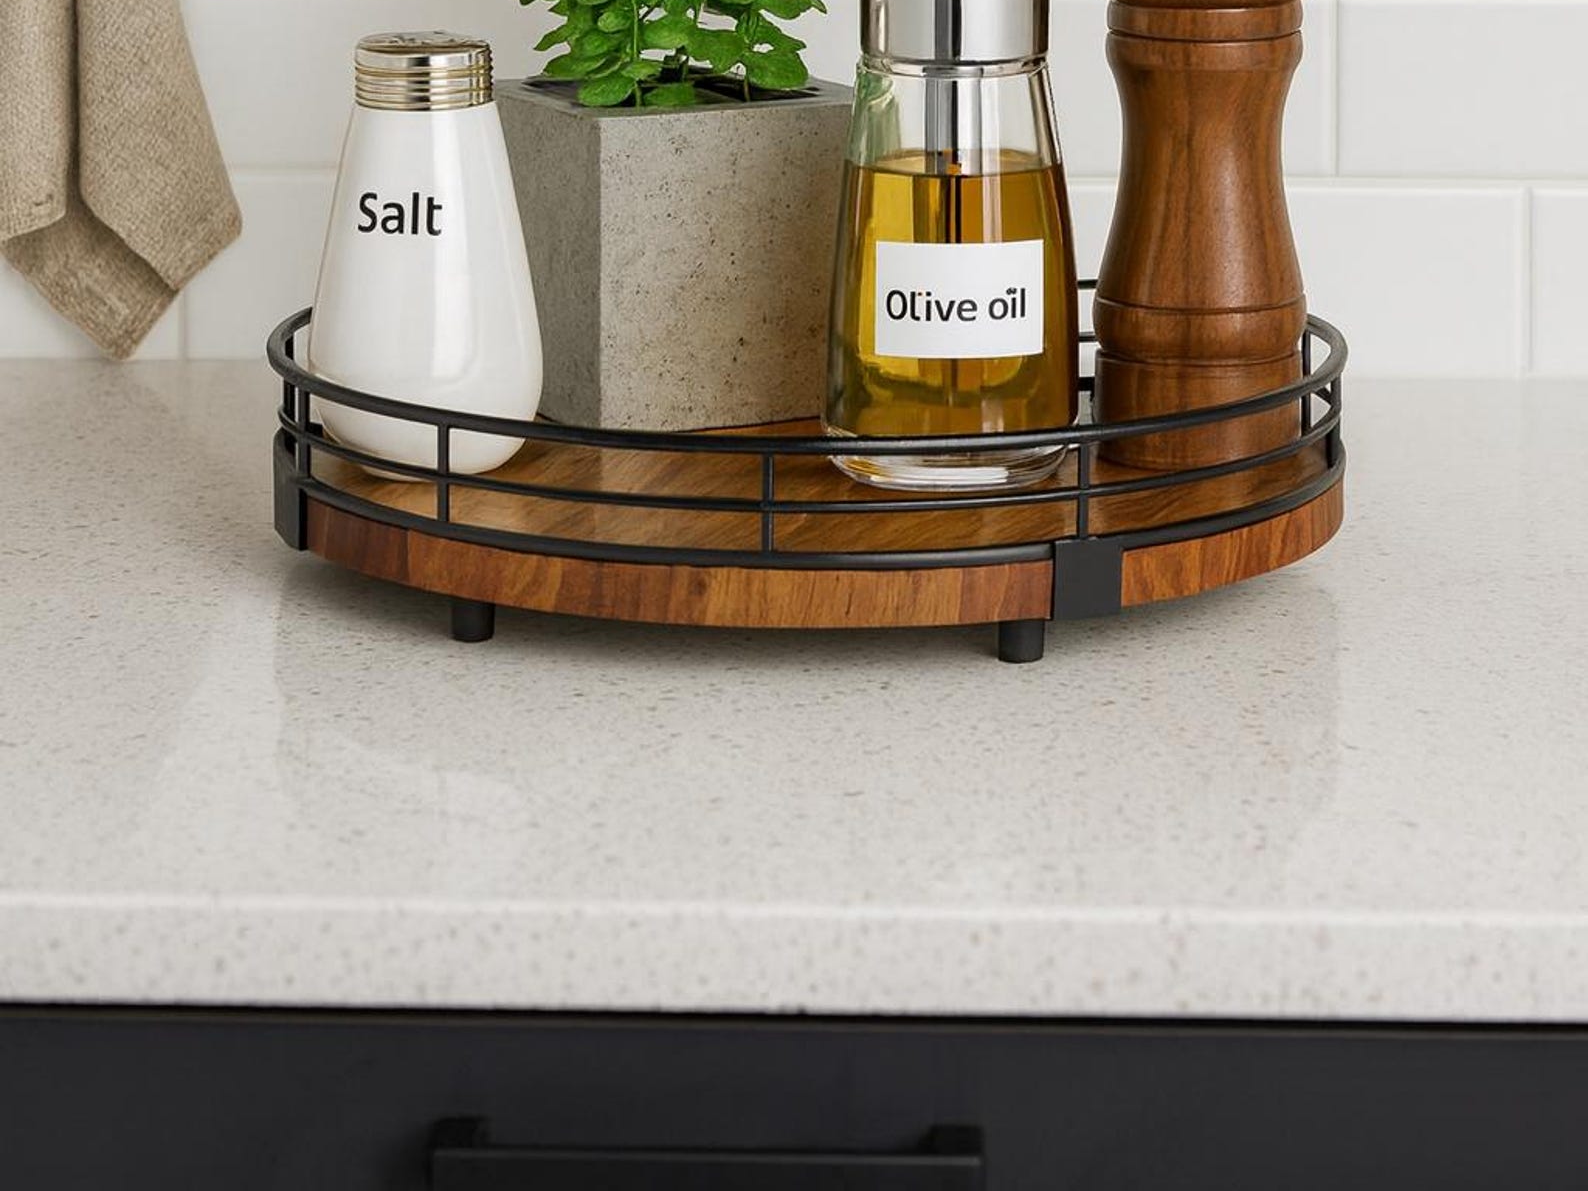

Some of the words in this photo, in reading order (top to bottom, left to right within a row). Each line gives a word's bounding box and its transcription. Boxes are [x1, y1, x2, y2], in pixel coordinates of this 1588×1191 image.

[357, 191, 443, 236] Salt
[885, 289, 978, 322] Olive
[988, 287, 1026, 320] oil
